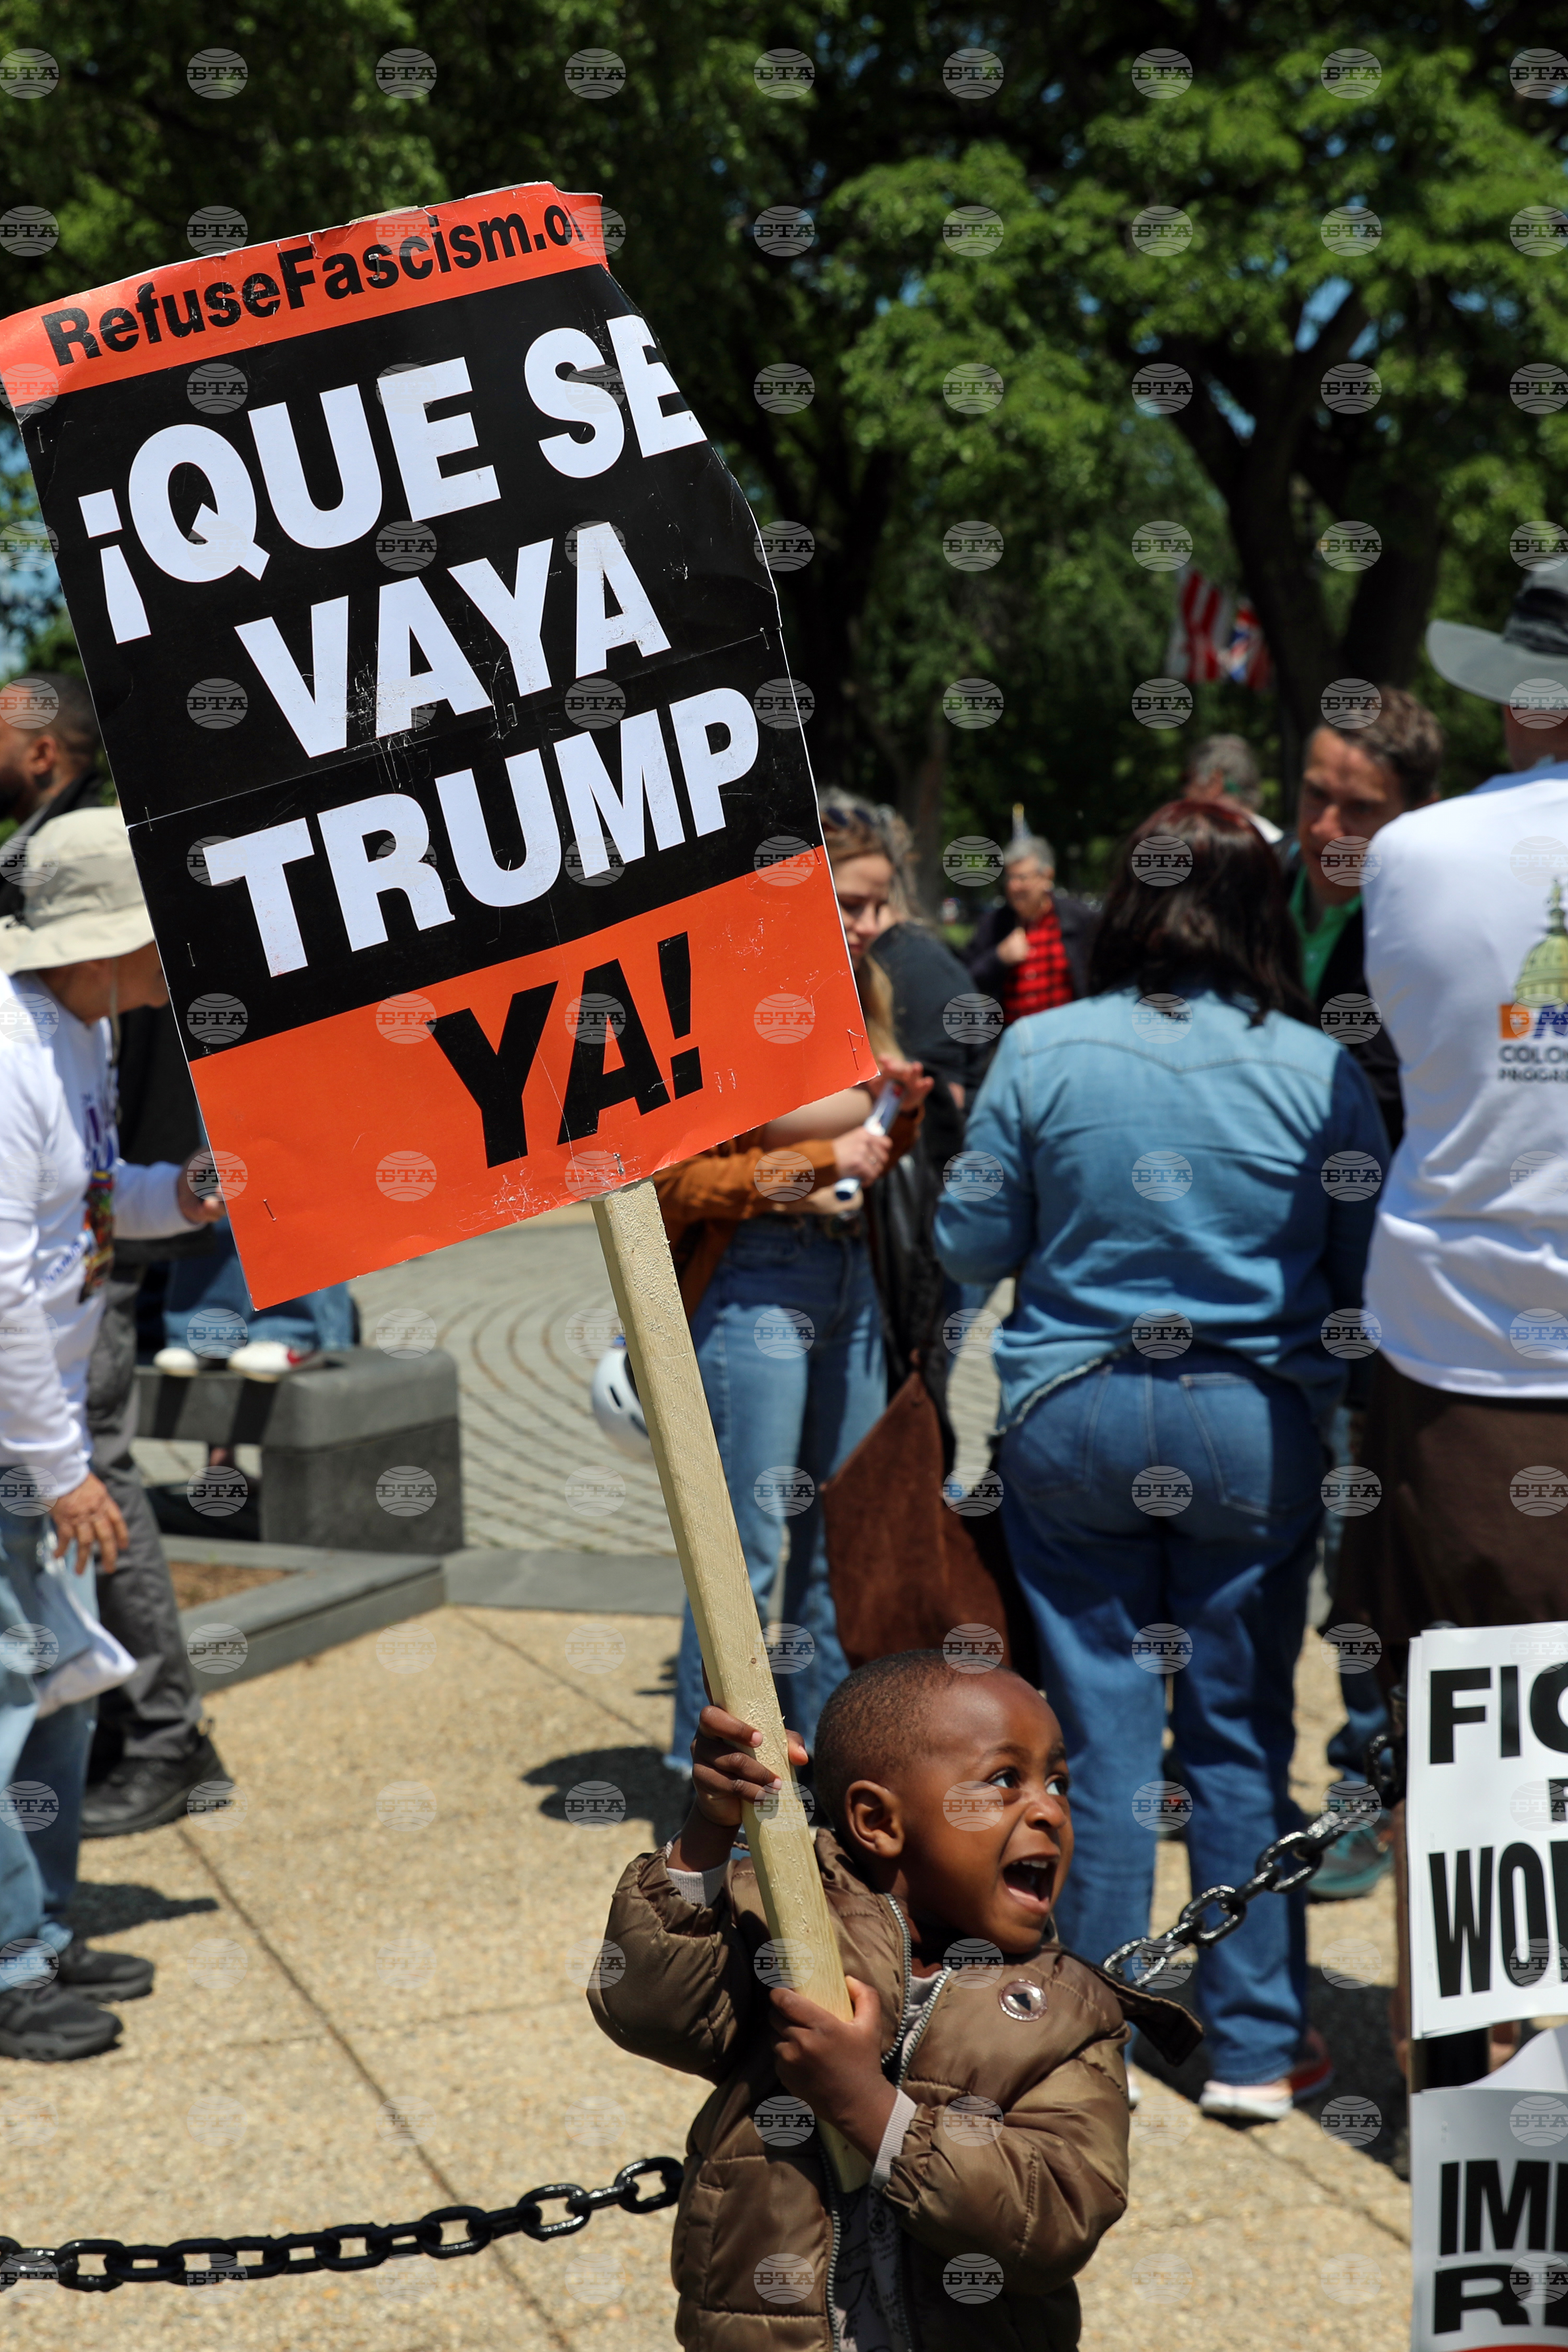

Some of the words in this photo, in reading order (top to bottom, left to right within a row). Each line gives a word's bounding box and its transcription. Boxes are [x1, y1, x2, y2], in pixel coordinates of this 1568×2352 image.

[41, 204, 585, 366] RefuseFascism.o
[78, 356, 501, 644] ¡QUE
[524, 314, 708, 479] SE
[234, 522, 671, 758] VAYA
[202, 688, 759, 978] TRUMP
[424, 931, 703, 1169] YA!
[1499, 1044, 1568, 1064] COLO
[1428, 1841, 1568, 1998] WO
[1440, 2159, 1568, 2257] IM
